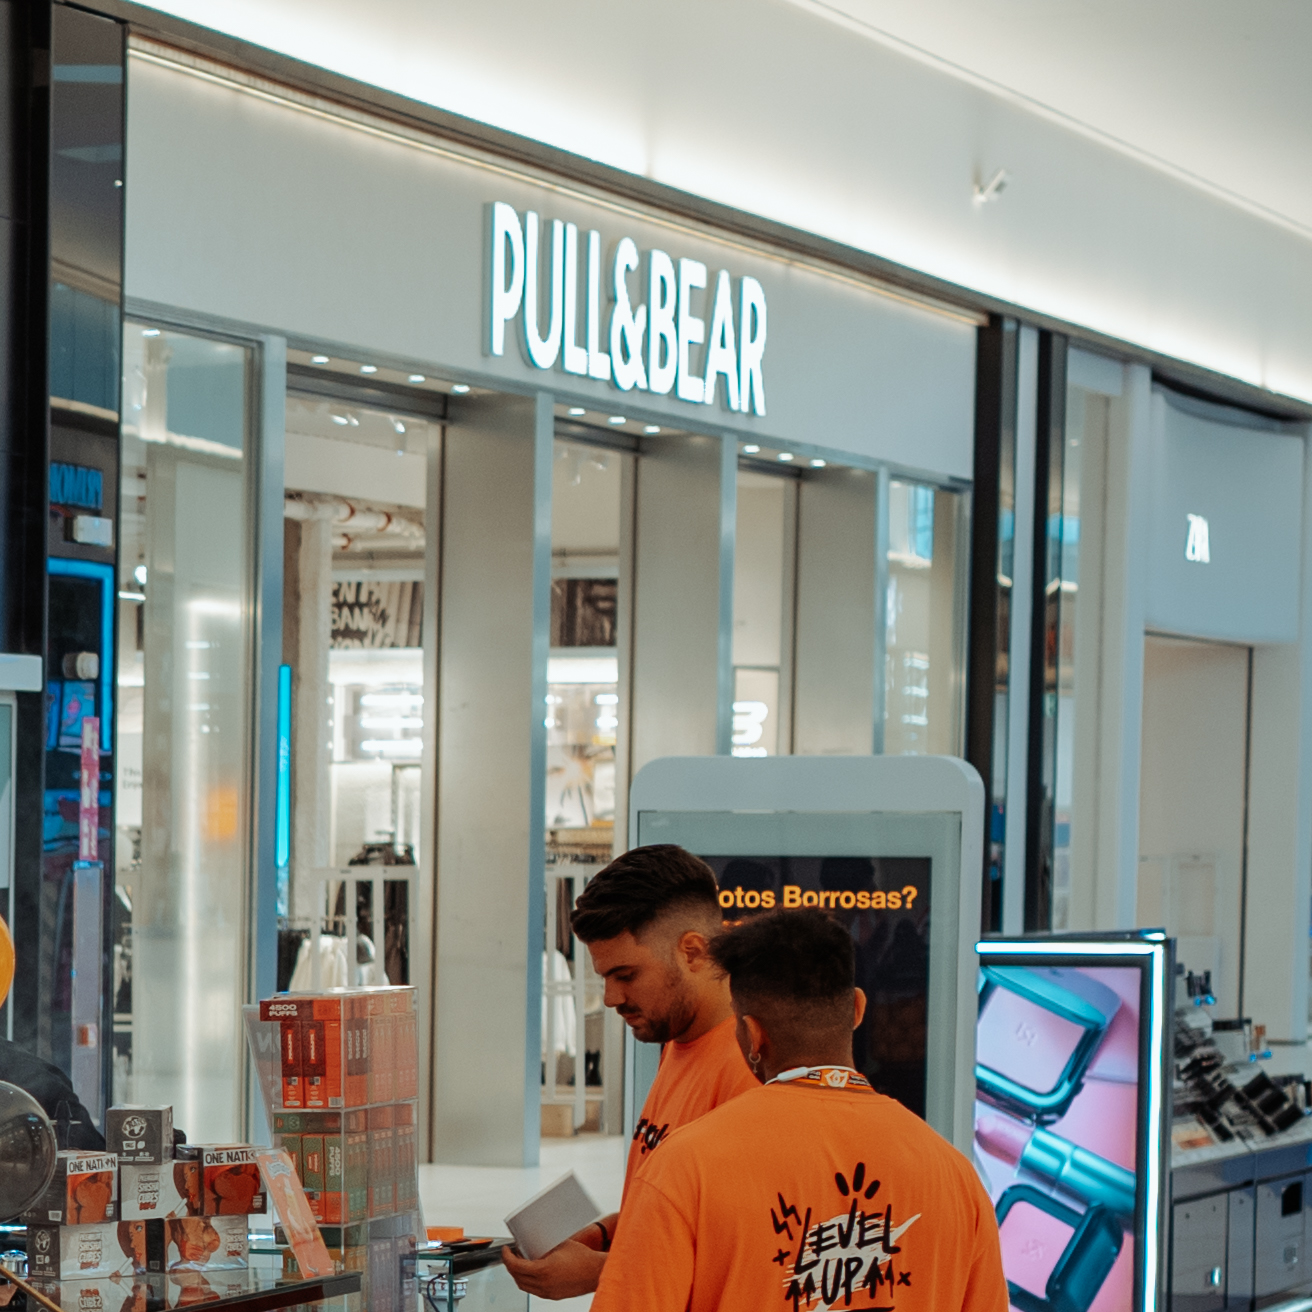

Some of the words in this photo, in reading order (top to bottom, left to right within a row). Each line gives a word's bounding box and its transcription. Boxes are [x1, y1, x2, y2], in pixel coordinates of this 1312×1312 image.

[487, 200, 769, 417] PULL&BEAR
[717, 885, 776, 909] otos
[782, 884, 919, 909] Borrosas?
[269, 1003, 297, 1011] 4500
[68, 1160, 84, 1173] ONE
[204, 1151, 225, 1165] ONE
[794, 1198, 902, 1276] LEVEL
